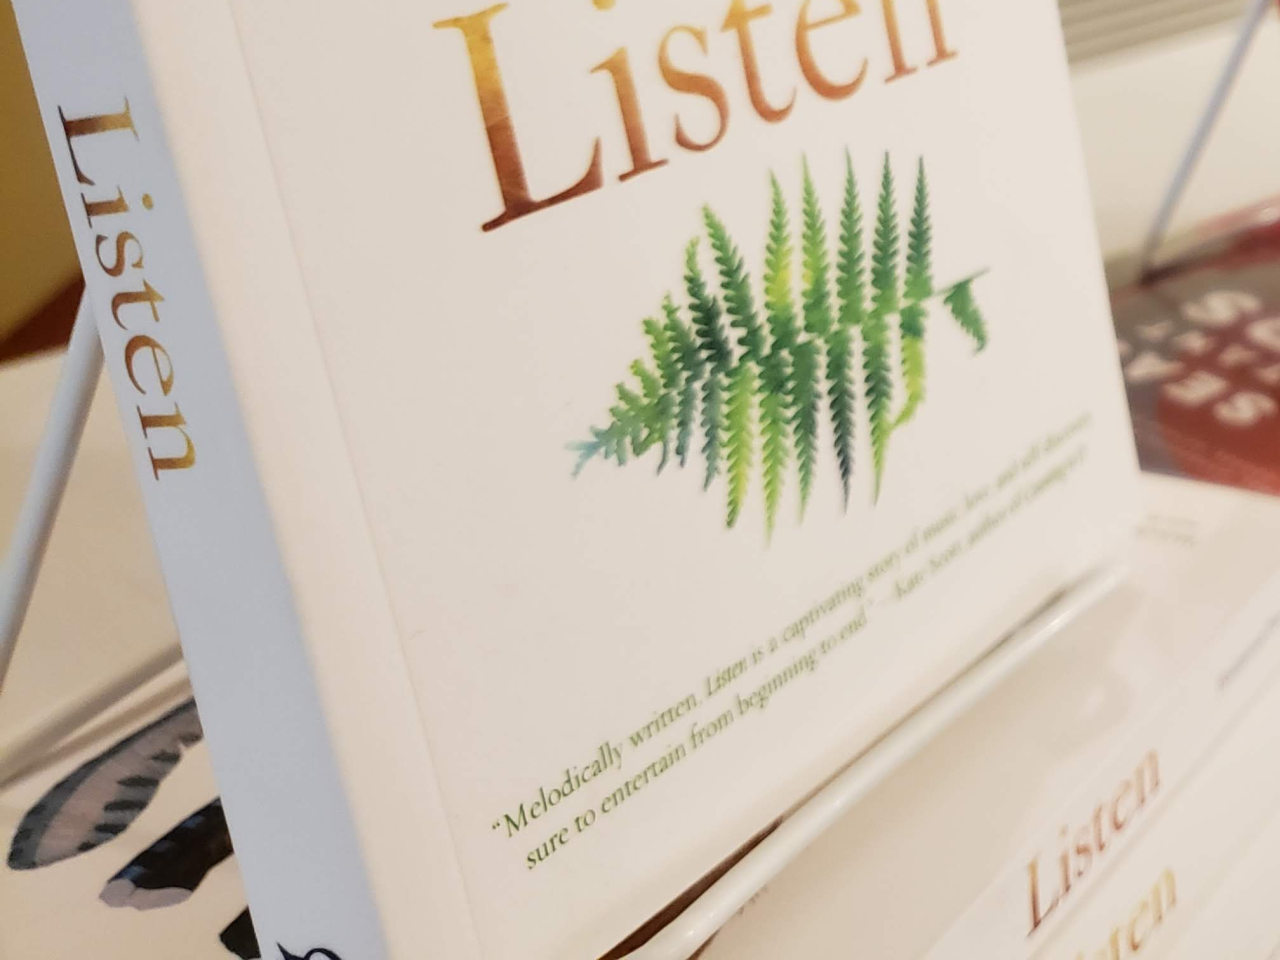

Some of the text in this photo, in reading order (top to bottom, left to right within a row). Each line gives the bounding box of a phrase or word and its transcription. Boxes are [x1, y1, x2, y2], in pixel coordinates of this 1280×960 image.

[57, 95, 197, 481] Listen
[525, 826, 570, 871] sure
[574, 808, 597, 834] to
[600, 742, 688, 816] entertain
[688, 706, 735, 751] from
[735, 648, 818, 718] beginning
[704, 657, 749, 697] Listen
[1026, 747, 1162, 939] Listen
